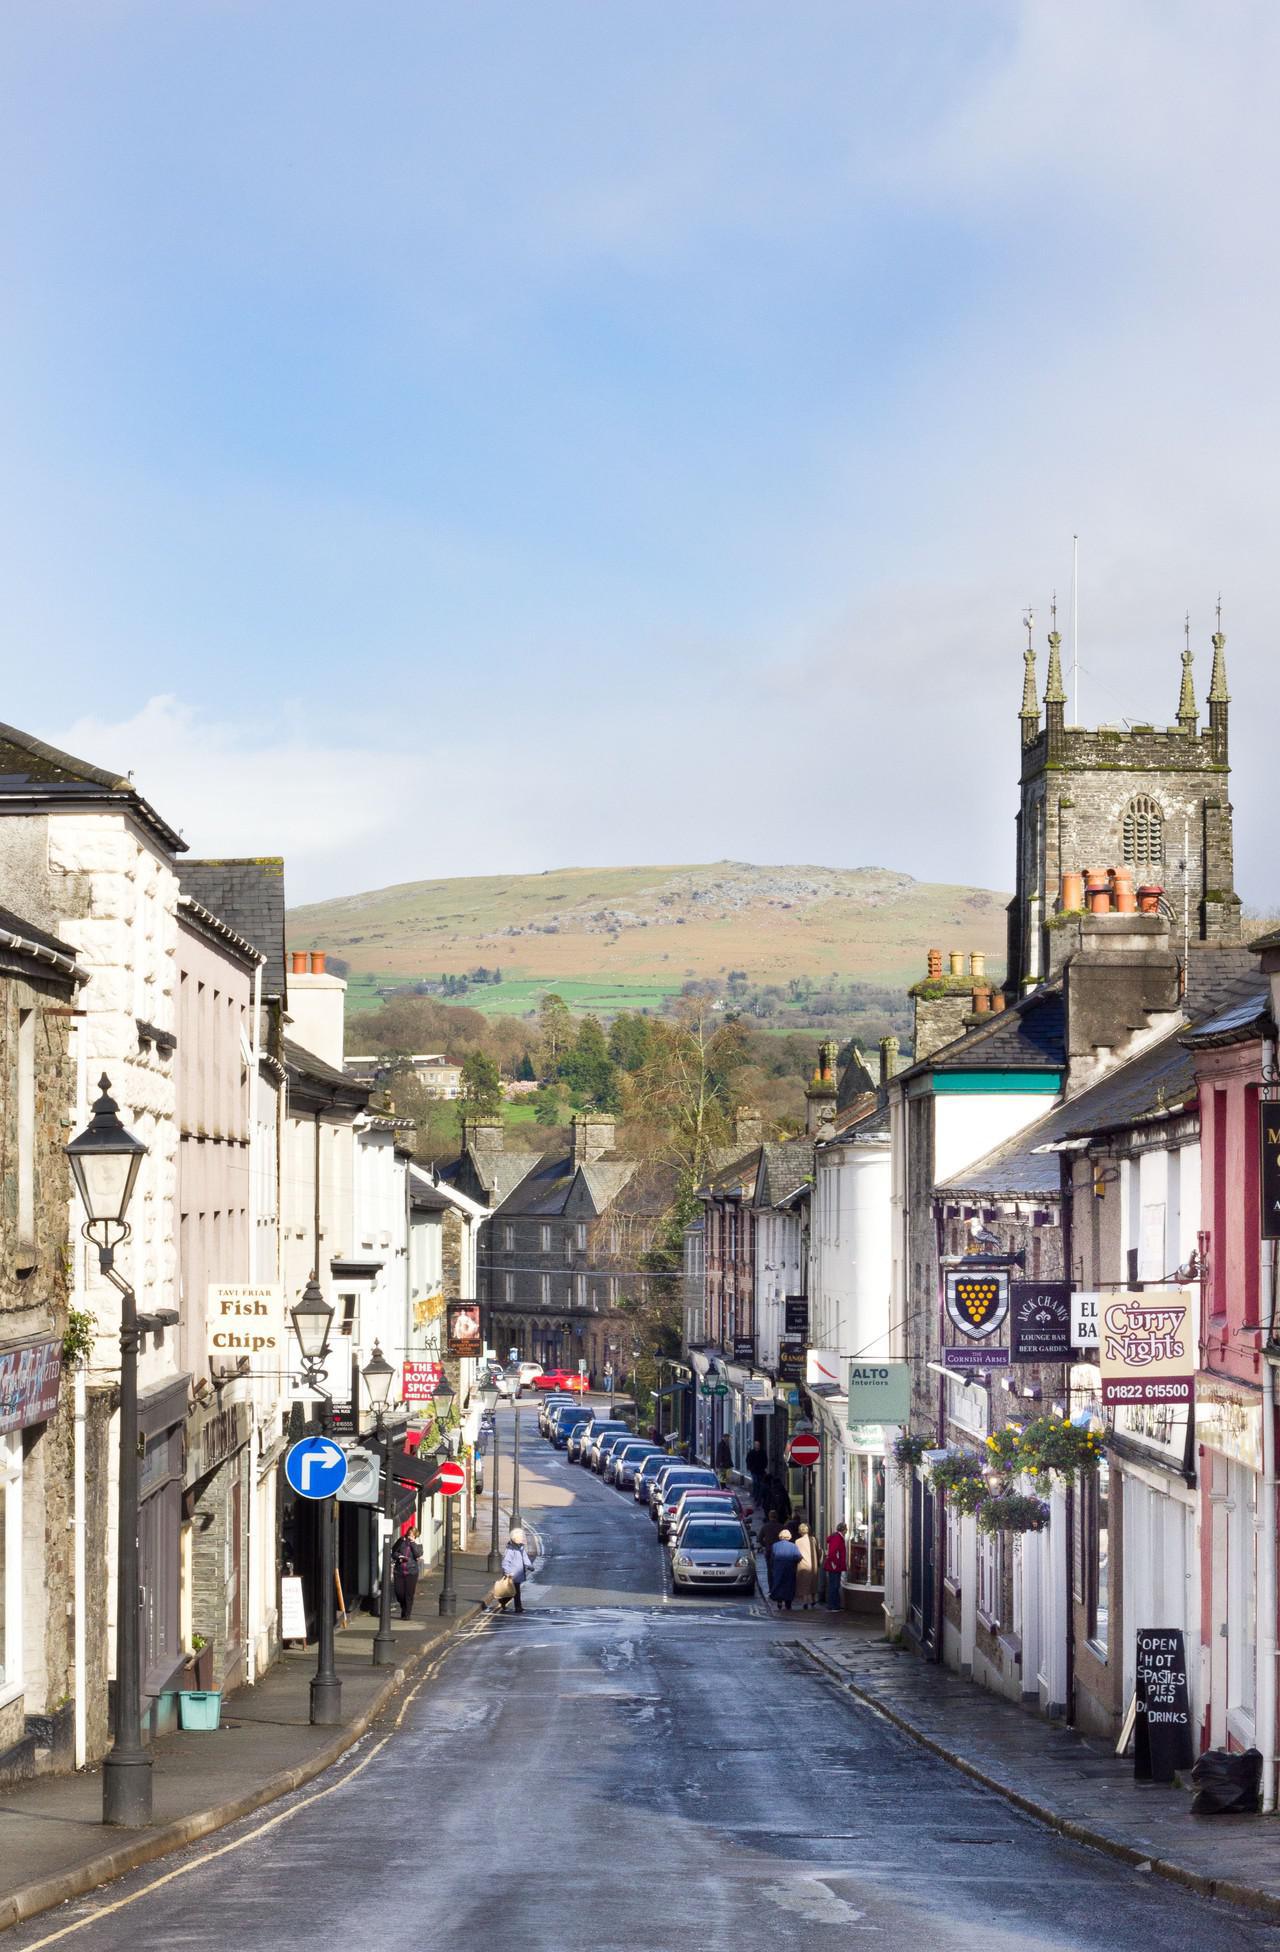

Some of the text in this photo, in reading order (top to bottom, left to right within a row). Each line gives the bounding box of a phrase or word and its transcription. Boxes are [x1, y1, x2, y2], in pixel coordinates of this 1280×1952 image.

[218, 1289, 272, 1297] TAVI FRIAR
[220, 1300, 268, 1315] Fish
[1017, 1295, 1070, 1322] JACK CHAM'S
[1105, 1300, 1187, 1337] Curry
[212, 1333, 276, 1352] Chips
[1105, 1331, 1185, 1367] Nights
[947, 1355, 1007, 1363] CORNISH ARMS
[412, 1363, 432, 1372] THE
[852, 1368, 889, 1379] ALTO
[405, 1373, 439, 1382] ROYAL
[1107, 1384, 1189, 1399] 01822 615500
[1142, 1638, 1177, 1651] OPEN
[1145, 1654, 1175, 1667] HOT
[1144, 1669, 1186, 1685] PASTIES
[1147, 1684, 1176, 1696] PIES
[1153, 1695, 1175, 1704] AND
[1148, 1710, 1188, 1724] DRINKS
